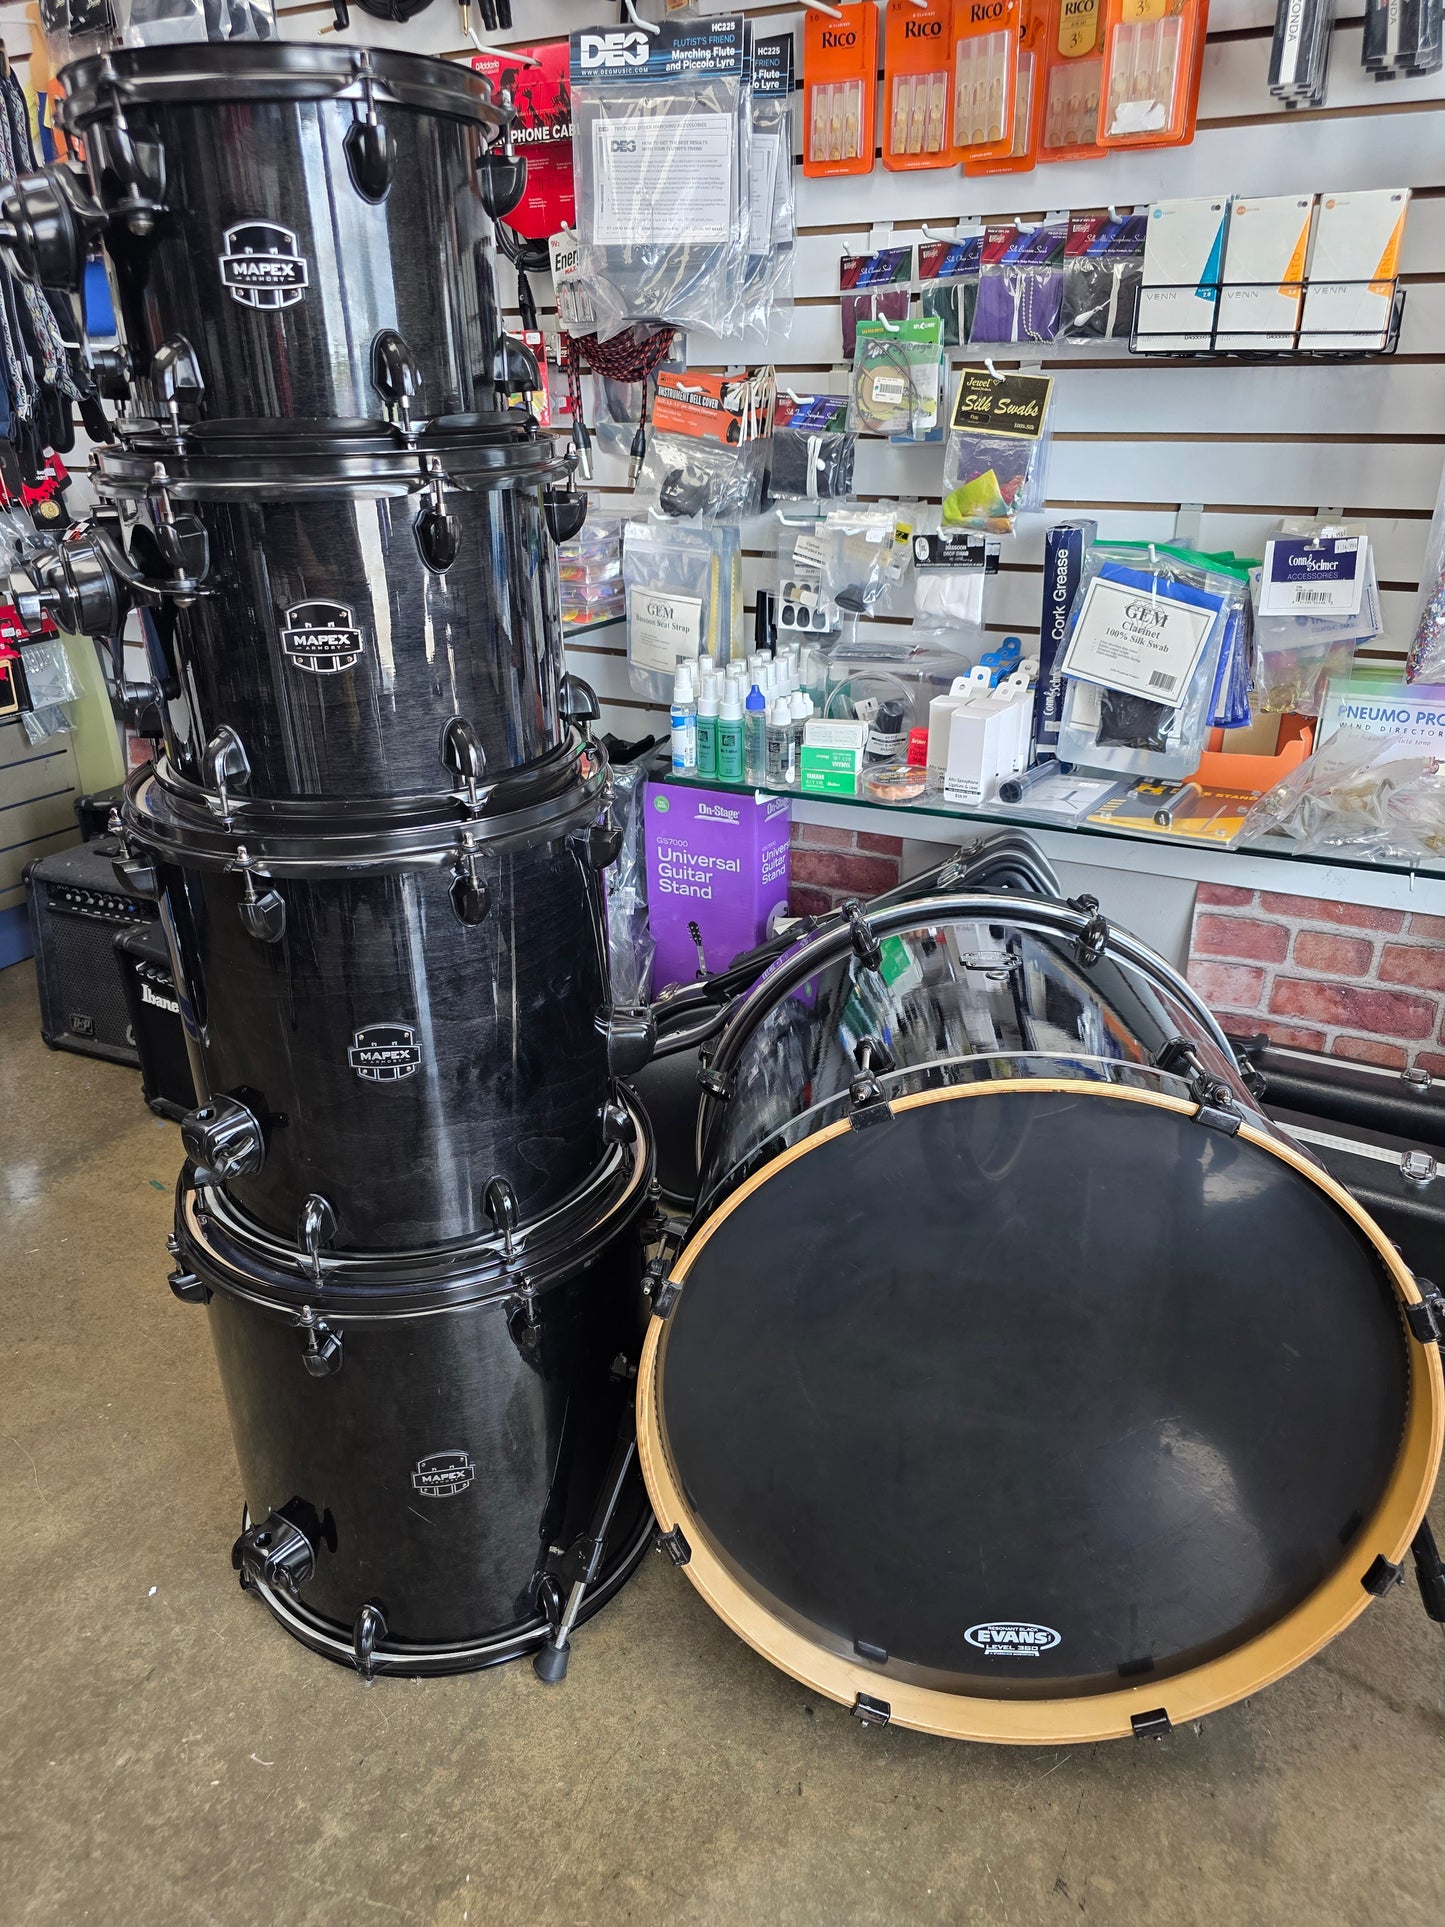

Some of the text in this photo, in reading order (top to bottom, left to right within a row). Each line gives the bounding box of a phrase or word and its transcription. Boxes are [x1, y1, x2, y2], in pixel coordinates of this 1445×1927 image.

[971, 2, 1003, 23] RICO
[1065, 0, 1094, 15] RICO
[711, 22, 735, 32] HC225
[1288, 0, 1301, 42] ONDA
[905, 20, 942, 38] RICO
[673, 35, 735, 47] FLUTIST'S FRIEND
[822, 31, 856, 48] RICO
[580, 31, 649, 68] DEG
[671, 47, 735, 61] Marching Flute
[757, 47, 780, 56] HC225
[581, 67, 649, 75] WWW.DEGMUSIC.COM
[665, 58, 735, 72] and Piccolo Lyre
[759, 70, 780, 78] Flute
[761, 80, 780, 90] Lyre
[510, 126, 550, 143] PHONE
[611, 140, 636, 153] DEG
[555, 250, 578, 272] Ener
[232, 262, 295, 276] MAPEX
[1147, 293, 1177, 301] VENN
[1227, 290, 1258, 299] VENN
[1313, 287, 1347, 295] VENN
[967, 377, 991, 387] Jewel
[658, 386, 719, 410] INSTRUMENT BELL COVER
[961, 394, 1039, 417] Silk Swabs
[1289, 555, 1338, 571] Conn Selmer
[1287, 572, 1338, 580] ACCESSORIES
[1051, 549, 1068, 640] Cork Grease
[647, 604, 674, 619] GEM
[1124, 604, 1169, 629] GEM
[656, 620, 670, 629] Seat
[672, 622, 690, 634] Strap
[1122, 621, 1160, 640] Clarinet
[294, 634, 351, 646] MAPEX
[1105, 628, 1128, 640] 100%
[1130, 635, 1146, 646] Silk
[1147, 640, 1170, 653] Swab
[1338, 705, 1411, 724] PNEUMO
[1340, 722, 1445, 738] WIND DIRECTOR
[806, 773, 825, 781] YAMAHA
[698, 803, 739, 819] On-Stage
[656, 837, 688, 847] GS7000
[658, 847, 740, 873] Universal
[762, 854, 786, 873] Guitar
[658, 863, 713, 883] Guitar
[762, 864, 786, 885] Stand
[659, 879, 712, 899] Stand
[141, 983, 180, 1014] Ibane
[360, 1050, 410, 1061] MAPEX
[422, 1471, 465, 1482] MAPEX
[978, 1630, 1047, 1644] EVANS
